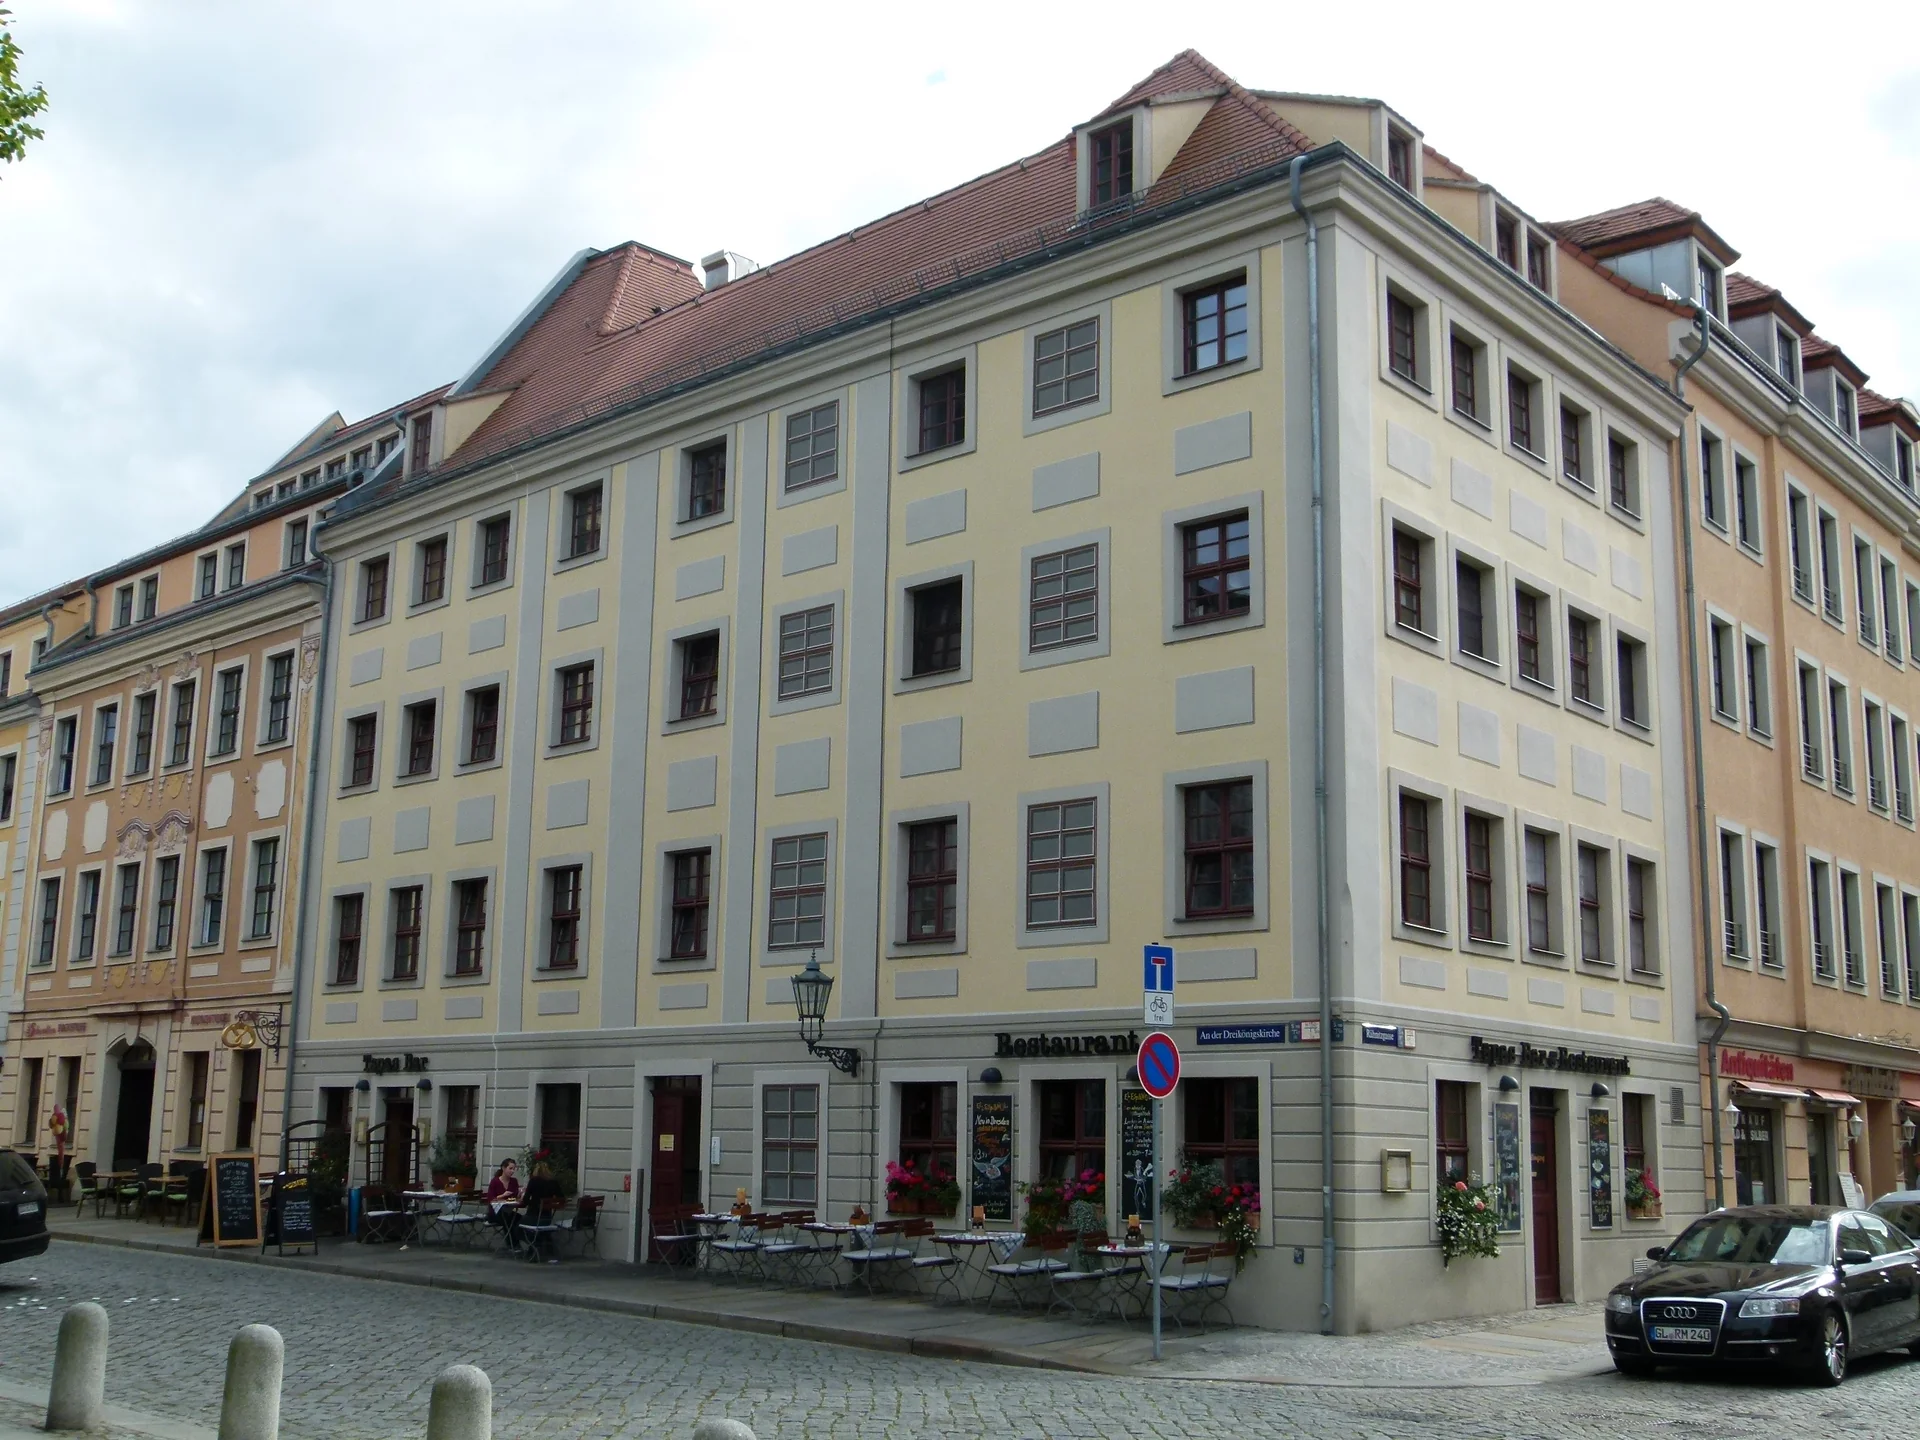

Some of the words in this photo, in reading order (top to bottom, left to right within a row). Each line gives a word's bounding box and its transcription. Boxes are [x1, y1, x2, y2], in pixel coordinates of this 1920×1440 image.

[1154, 1013, 1165, 1022] frei
[994, 1030, 1140, 1058] Restaurant
[1200, 1030, 1211, 1040] An
[1211, 1030, 1222, 1040] der
[1223, 1028, 1281, 1041] Dreikönigskirche
[363, 1053, 400, 1076] Tapas
[403, 1053, 430, 1073] Bar
[1471, 1036, 1516, 1067] Tapas
[1520, 1042, 1547, 1070] Bar
[1557, 1046, 1631, 1075] Restaurant
[1720, 1048, 1795, 1082] Antiquitäten
[1655, 1327, 1668, 1339] GL
[1674, 1328, 1688, 1340] RM
[1690, 1329, 1710, 1341] 240
